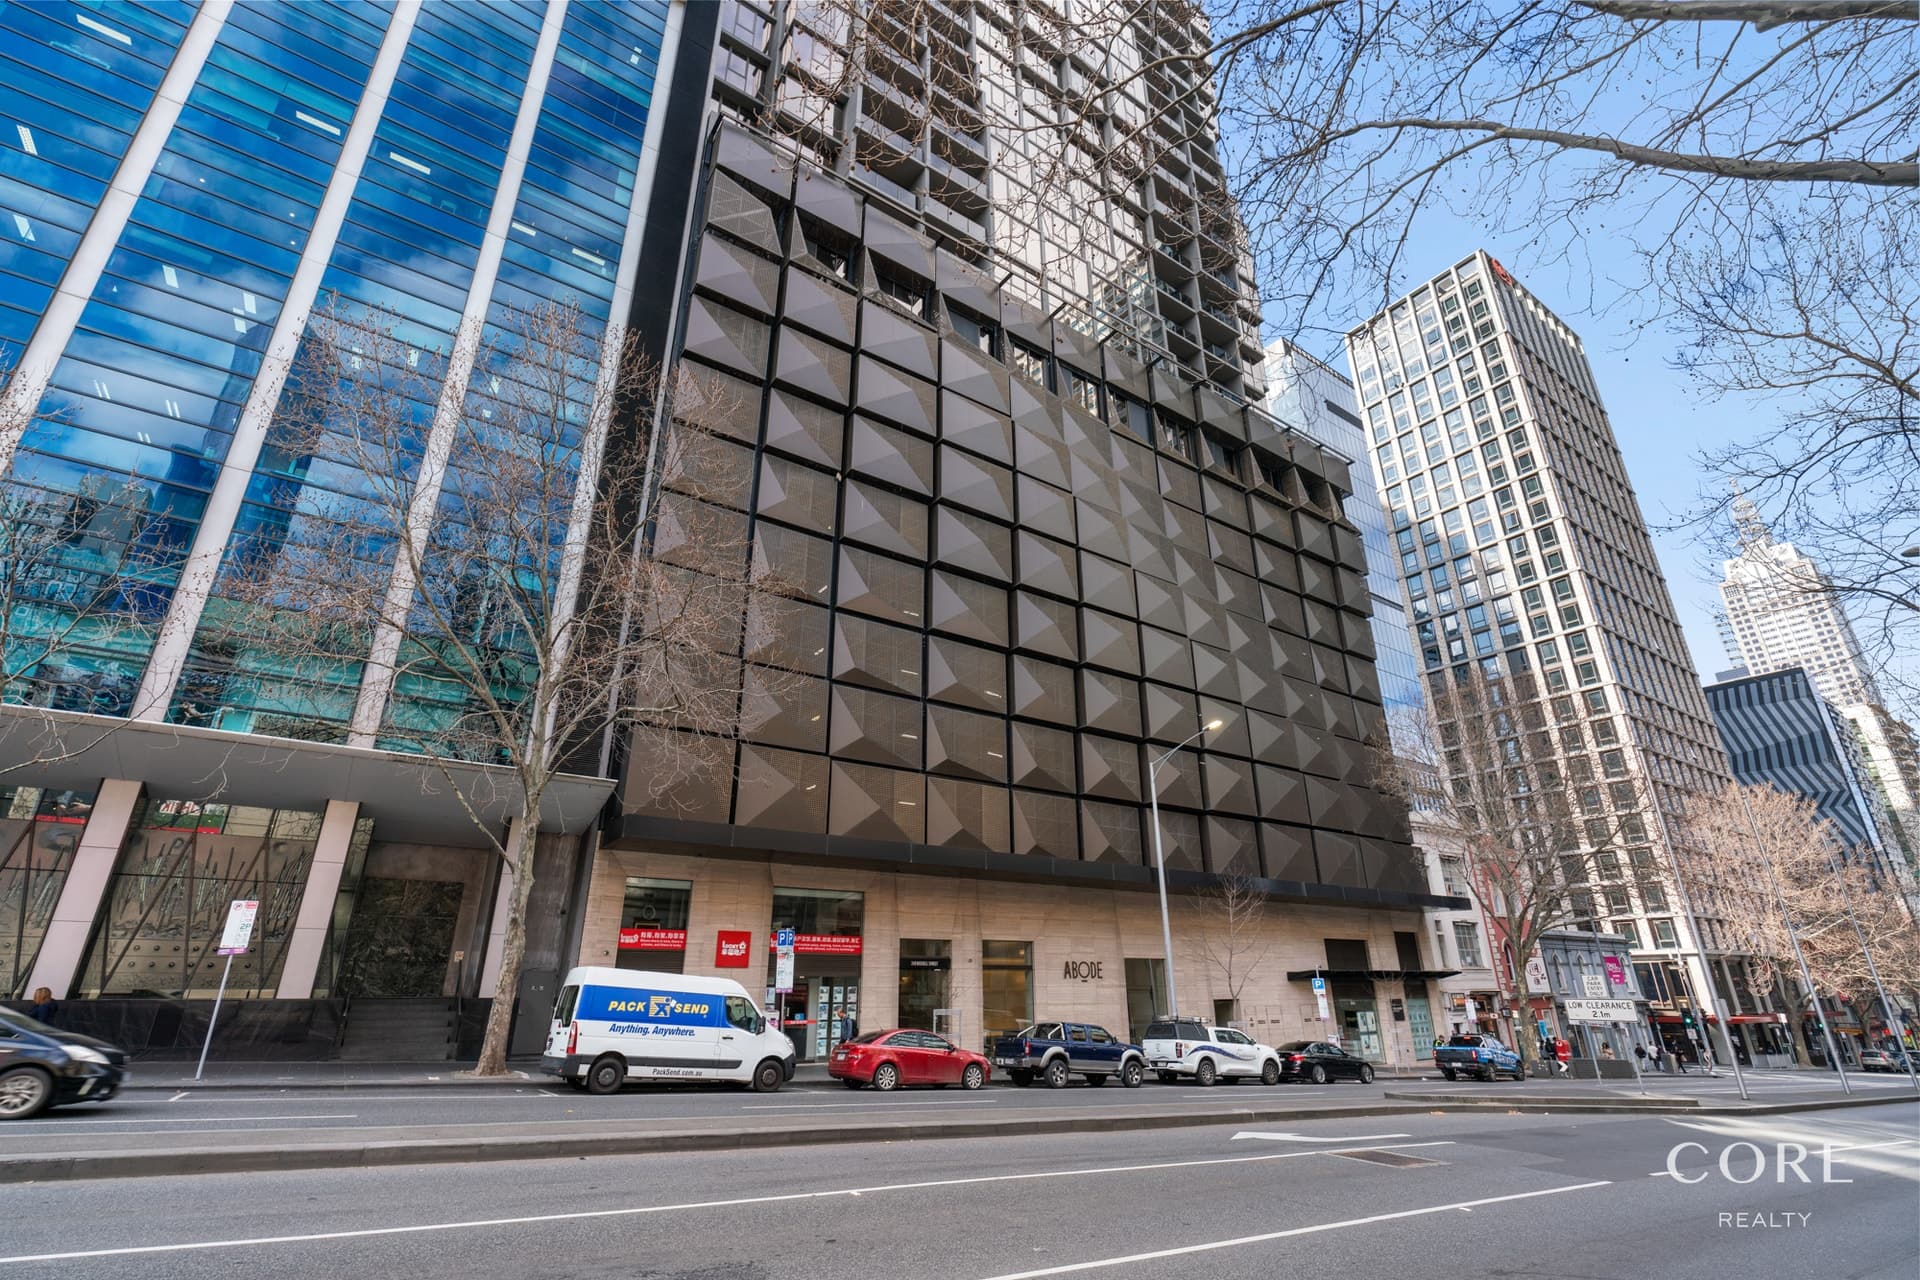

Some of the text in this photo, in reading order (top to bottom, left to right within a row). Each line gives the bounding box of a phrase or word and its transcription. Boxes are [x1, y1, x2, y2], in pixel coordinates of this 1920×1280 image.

[779, 932, 786, 945] P
[1064, 960, 1103, 981] ABODE
[1315, 980, 1322, 989] P
[608, 1000, 710, 1015] PACK SEND
[1568, 1001, 1632, 1010] LOW CLEARANCE
[1592, 1010, 1611, 1018] 2.1m
[609, 1023, 696, 1037] Anything. Anywhere.
[652, 1068, 703, 1077] PackSend.com.au
